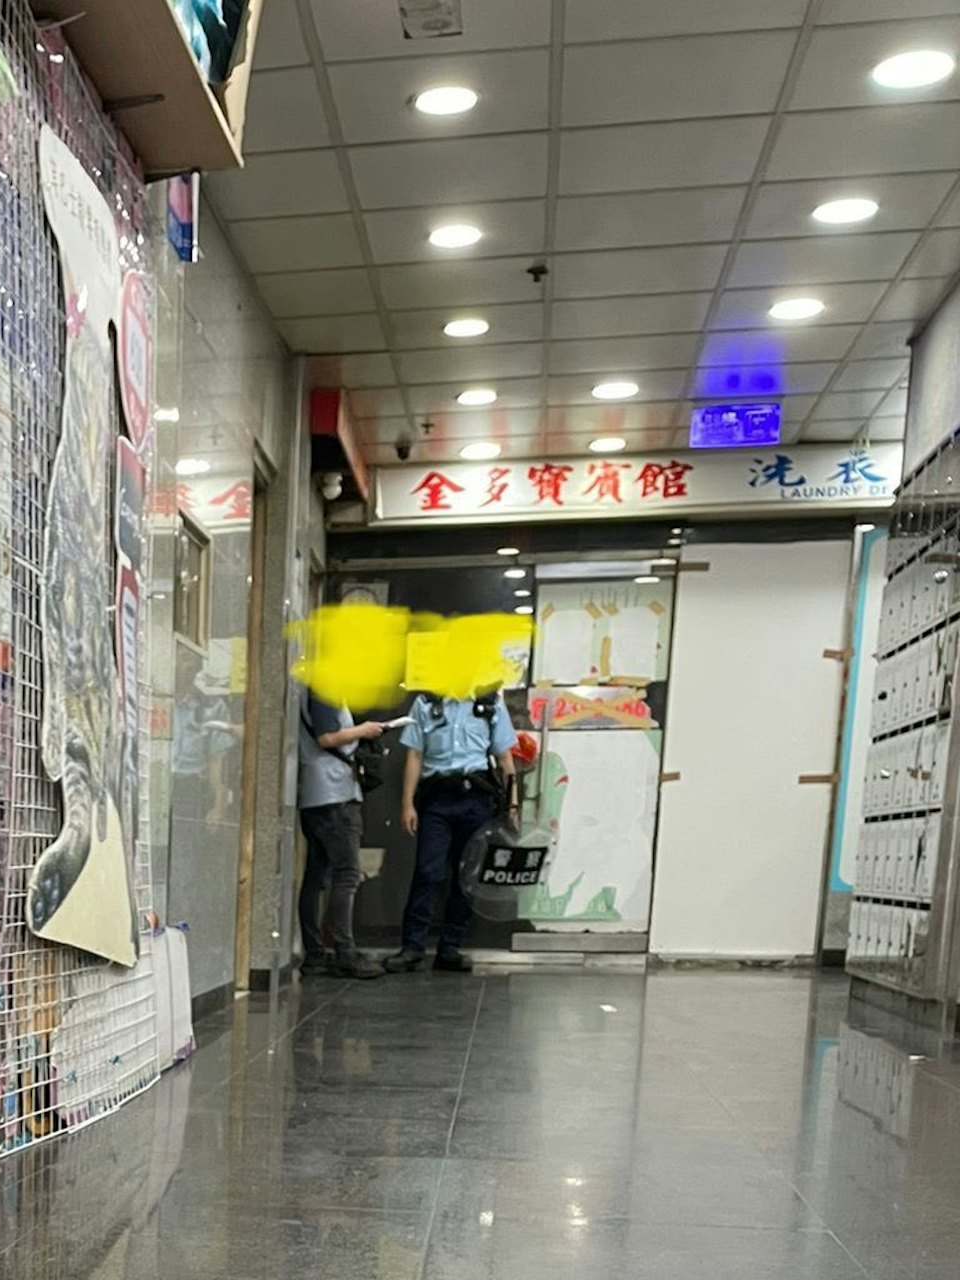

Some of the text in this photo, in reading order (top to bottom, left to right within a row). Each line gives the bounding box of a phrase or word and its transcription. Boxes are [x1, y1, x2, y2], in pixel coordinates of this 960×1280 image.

[410, 460, 694, 511] 金多寶賓館
[780, 485, 862, 499] LAUNDRY
[483, 869, 538, 884] POLICE
